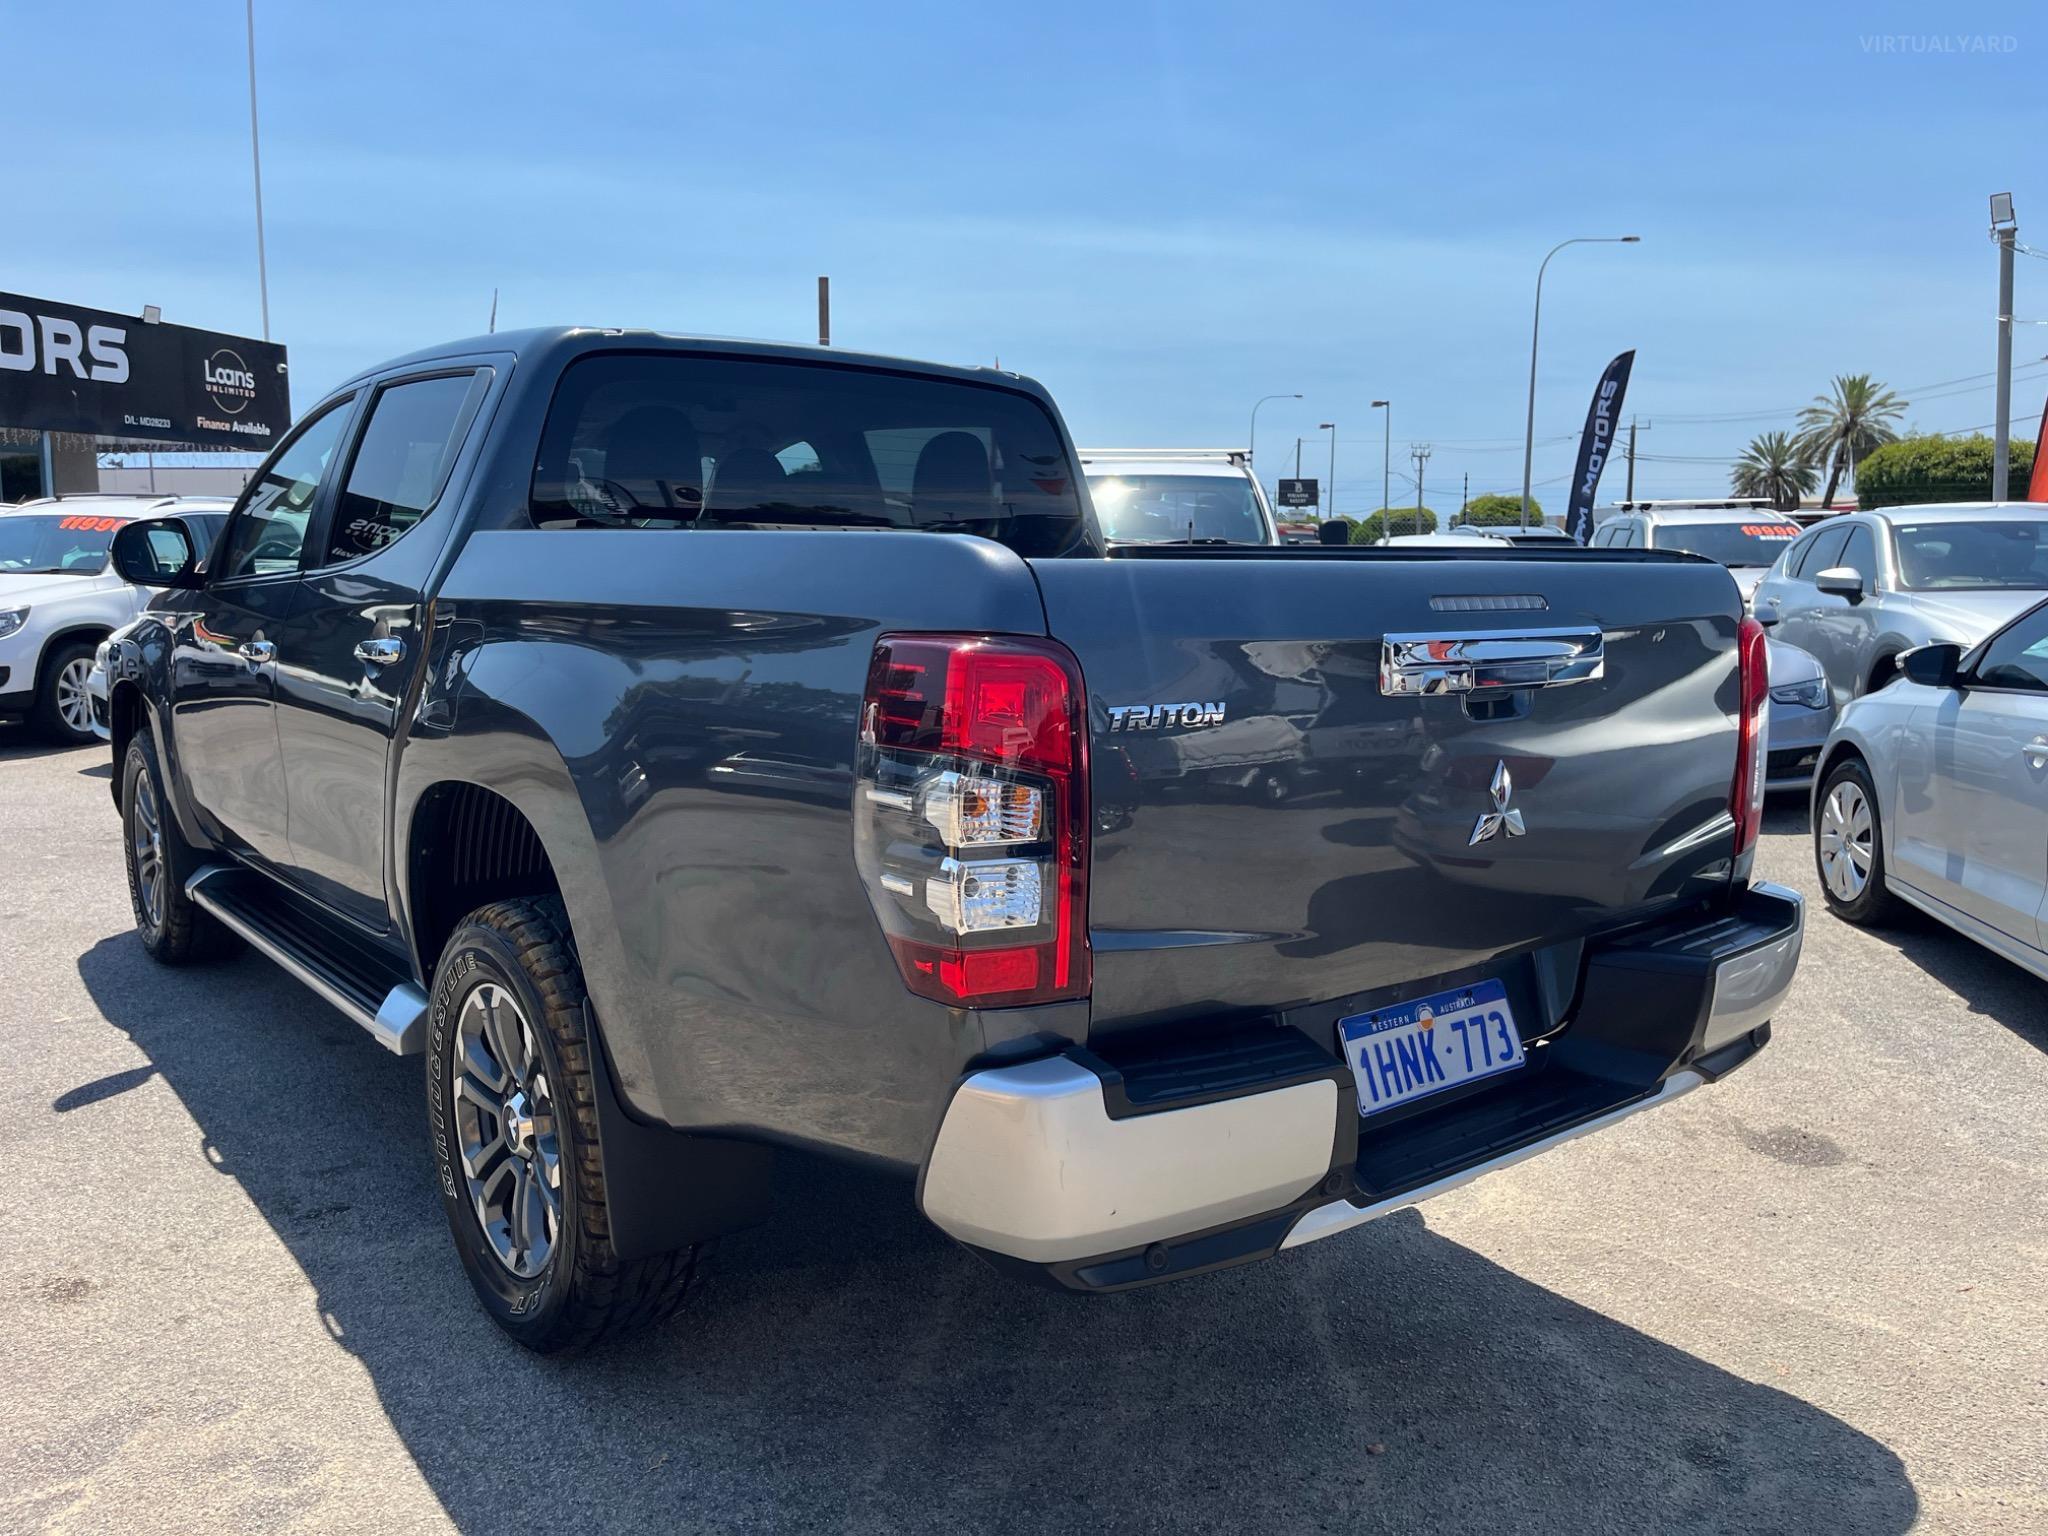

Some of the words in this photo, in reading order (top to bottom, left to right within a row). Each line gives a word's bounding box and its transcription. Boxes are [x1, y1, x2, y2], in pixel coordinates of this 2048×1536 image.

[204, 360, 255, 389] Loans
[205, 384, 256, 398] UNLIMITED
[197, 416, 231, 431] Finance
[232, 421, 271, 436] Available
[1582, 379, 1618, 495] MOTORS
[1108, 702, 1226, 732] TRITON
[1371, 1015, 1410, 1032] WESTERN
[1440, 996, 1476, 1014] AUSTRALIA
[431, 952, 477, 1199] BRIDGESTONE
